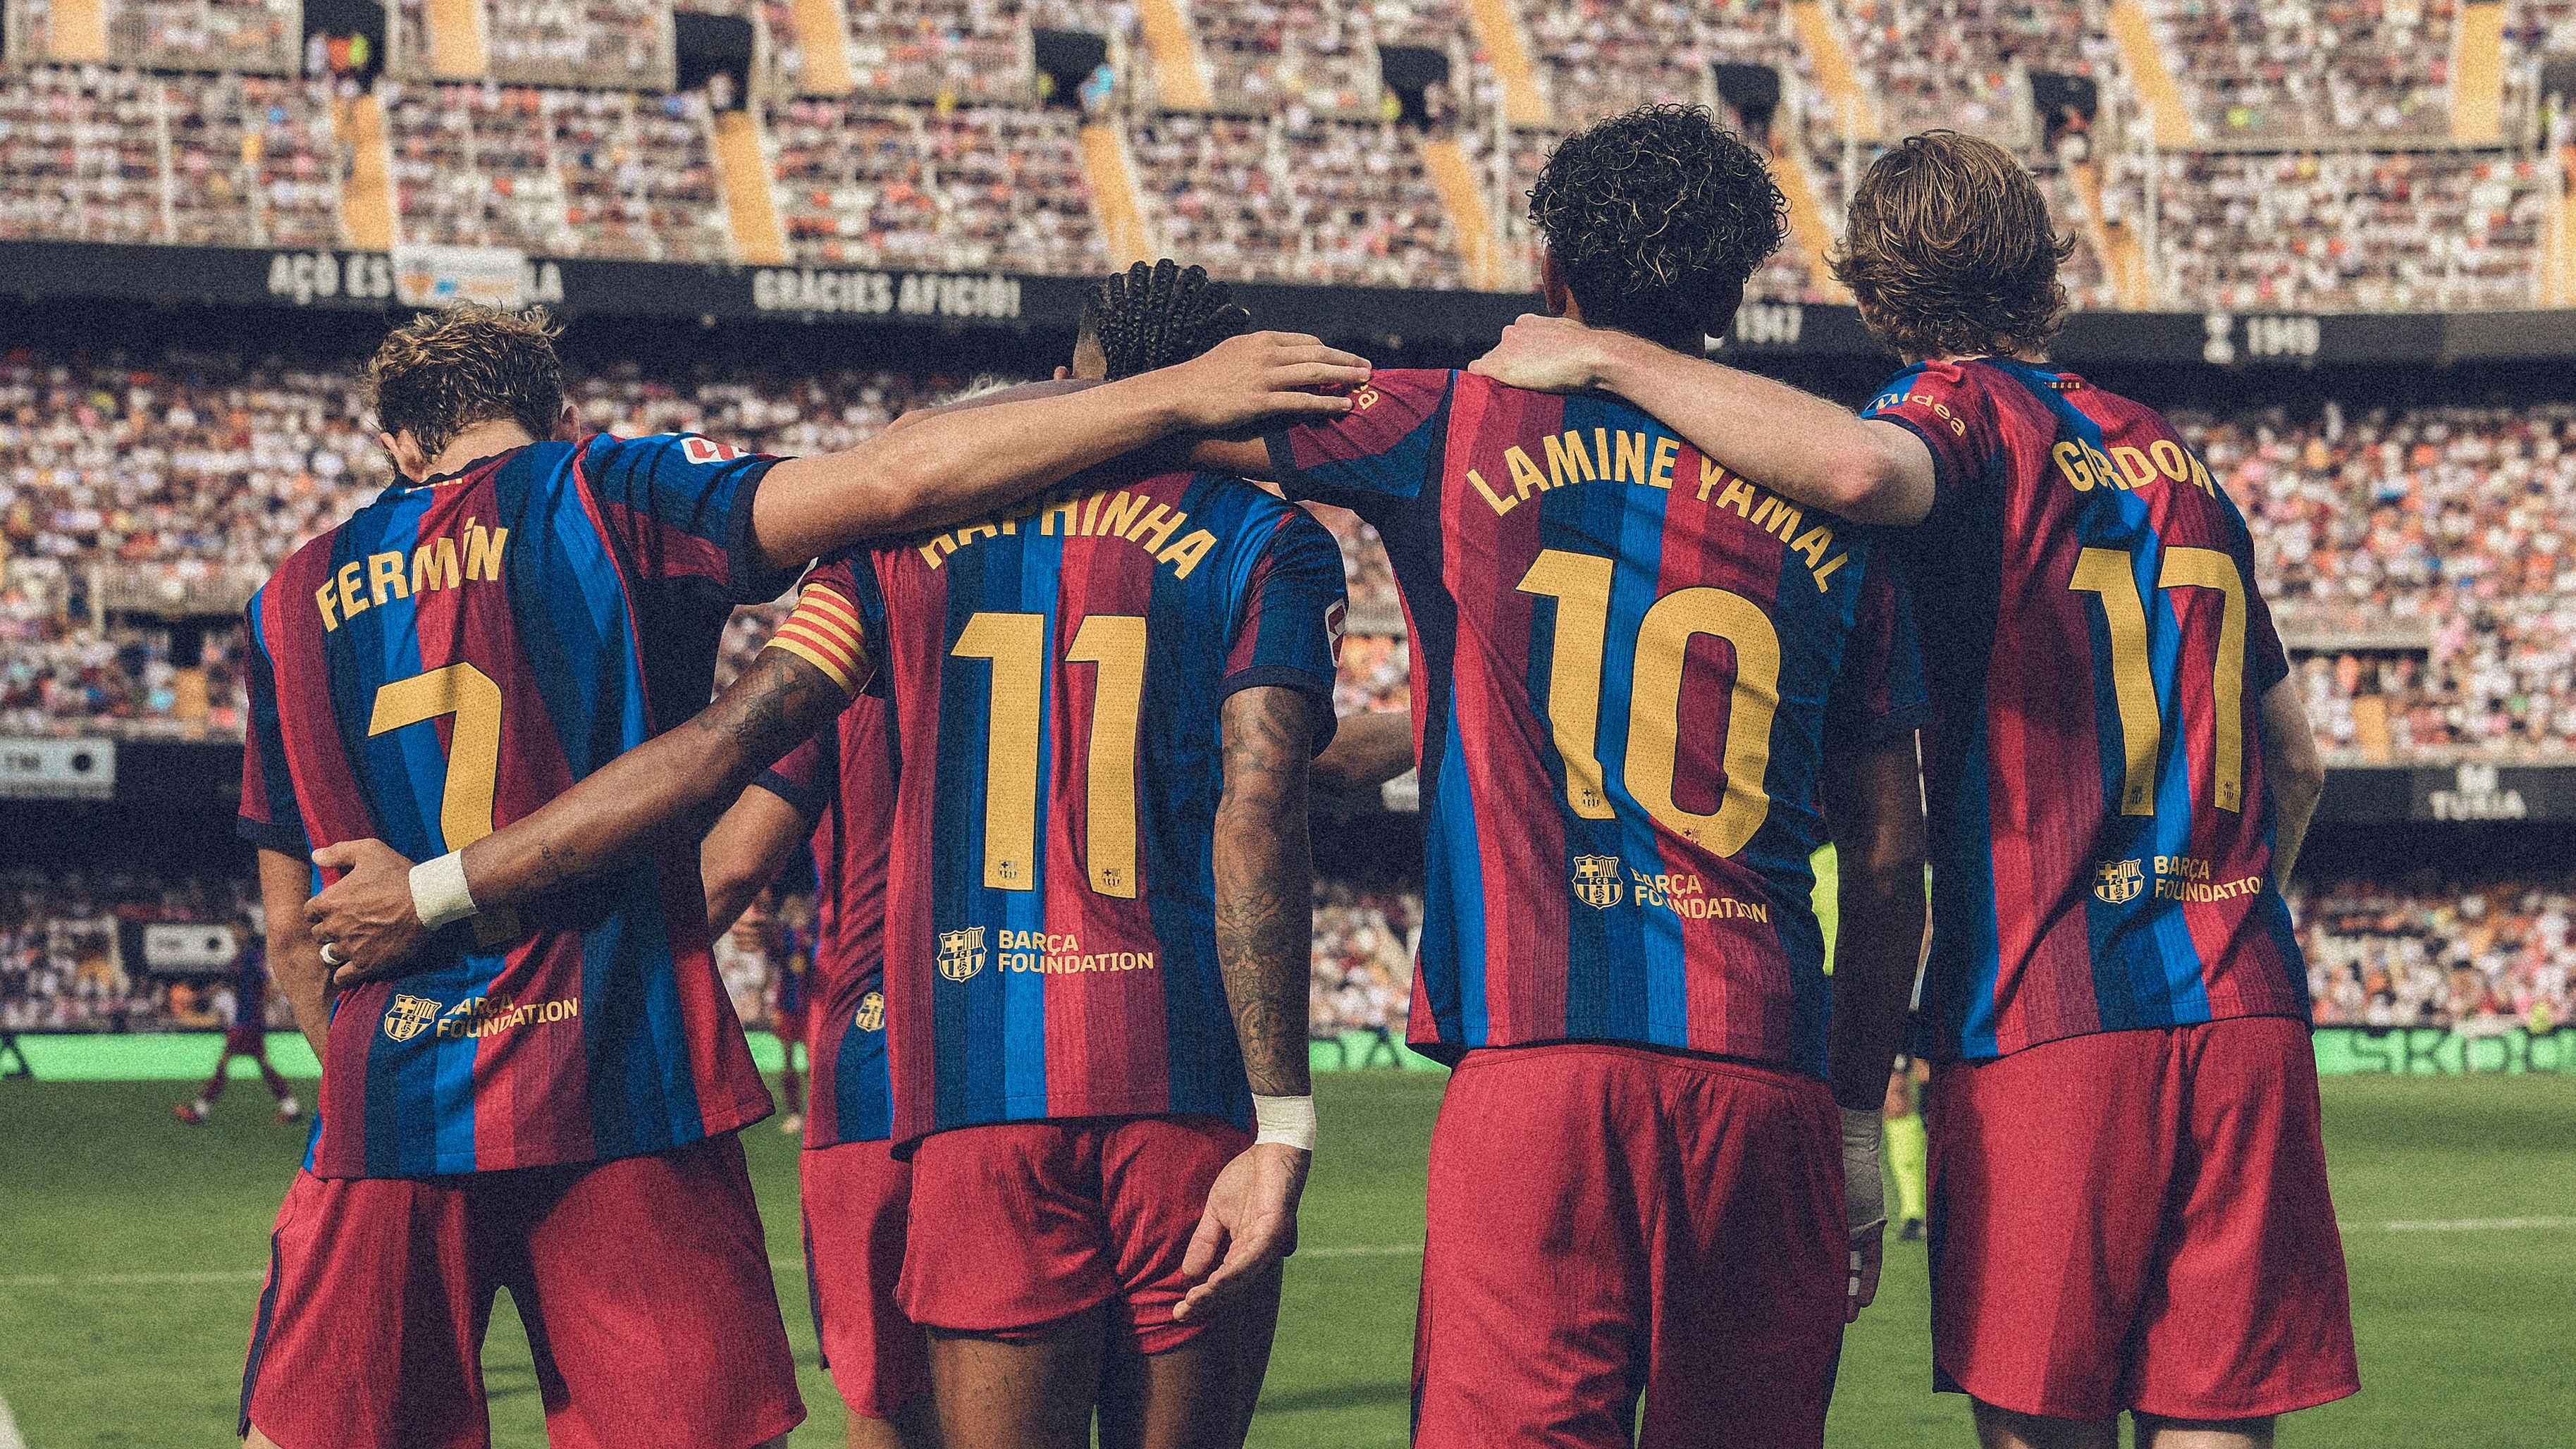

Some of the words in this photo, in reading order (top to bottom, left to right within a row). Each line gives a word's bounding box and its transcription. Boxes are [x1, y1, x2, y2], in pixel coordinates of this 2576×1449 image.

[1875, 392, 1966, 437] Midea
[2052, 436, 2216, 500] GORDON
[1466, 428, 1680, 517] LAMINE
[1696, 457, 1848, 593] YAMAL
[315, 516, 509, 632] FERMÍN
[1515, 548, 1782, 858] 10
[2069, 546, 2247, 816] 17
[951, 611, 1147, 899] 11
[367, 661, 520, 947] 7
[2154, 856, 2210, 882] BARÇA
[2154, 876, 2264, 903] FOUNDATIO
[1634, 885, 1768, 923] FOUNDATION
[953, 949, 972, 958] FCB
[997, 951, 1154, 975] FOUNDATION
[998, 929, 1079, 957] BARÇA
[401, 1013, 421, 1023] FCB
[435, 996, 578, 1039] FOUNDATION
